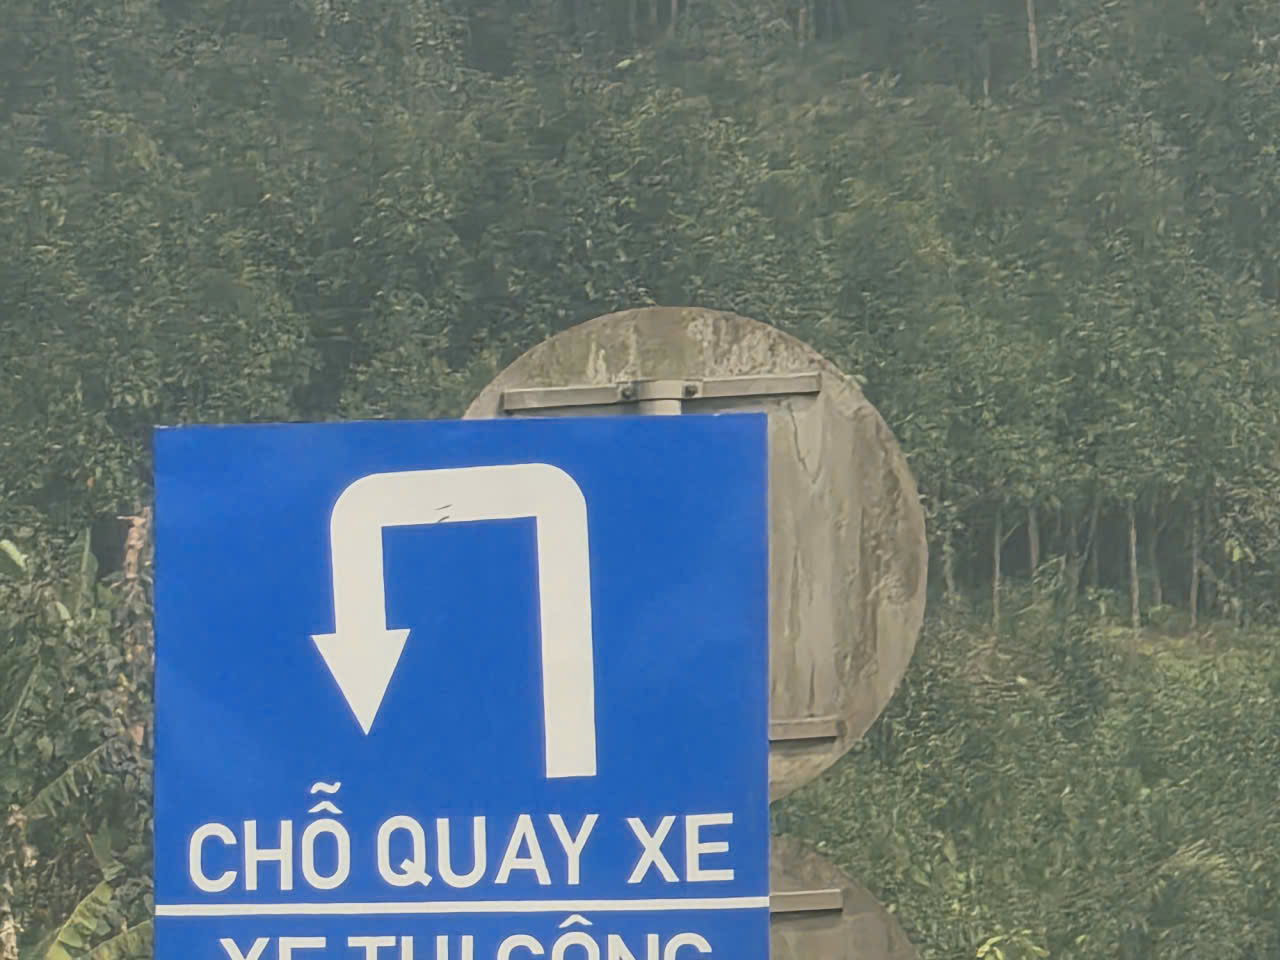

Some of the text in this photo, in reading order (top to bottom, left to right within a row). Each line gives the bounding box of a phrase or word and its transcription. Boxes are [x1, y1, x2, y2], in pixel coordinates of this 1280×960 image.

[188, 781, 735, 893] CHỖ QUAY XE
